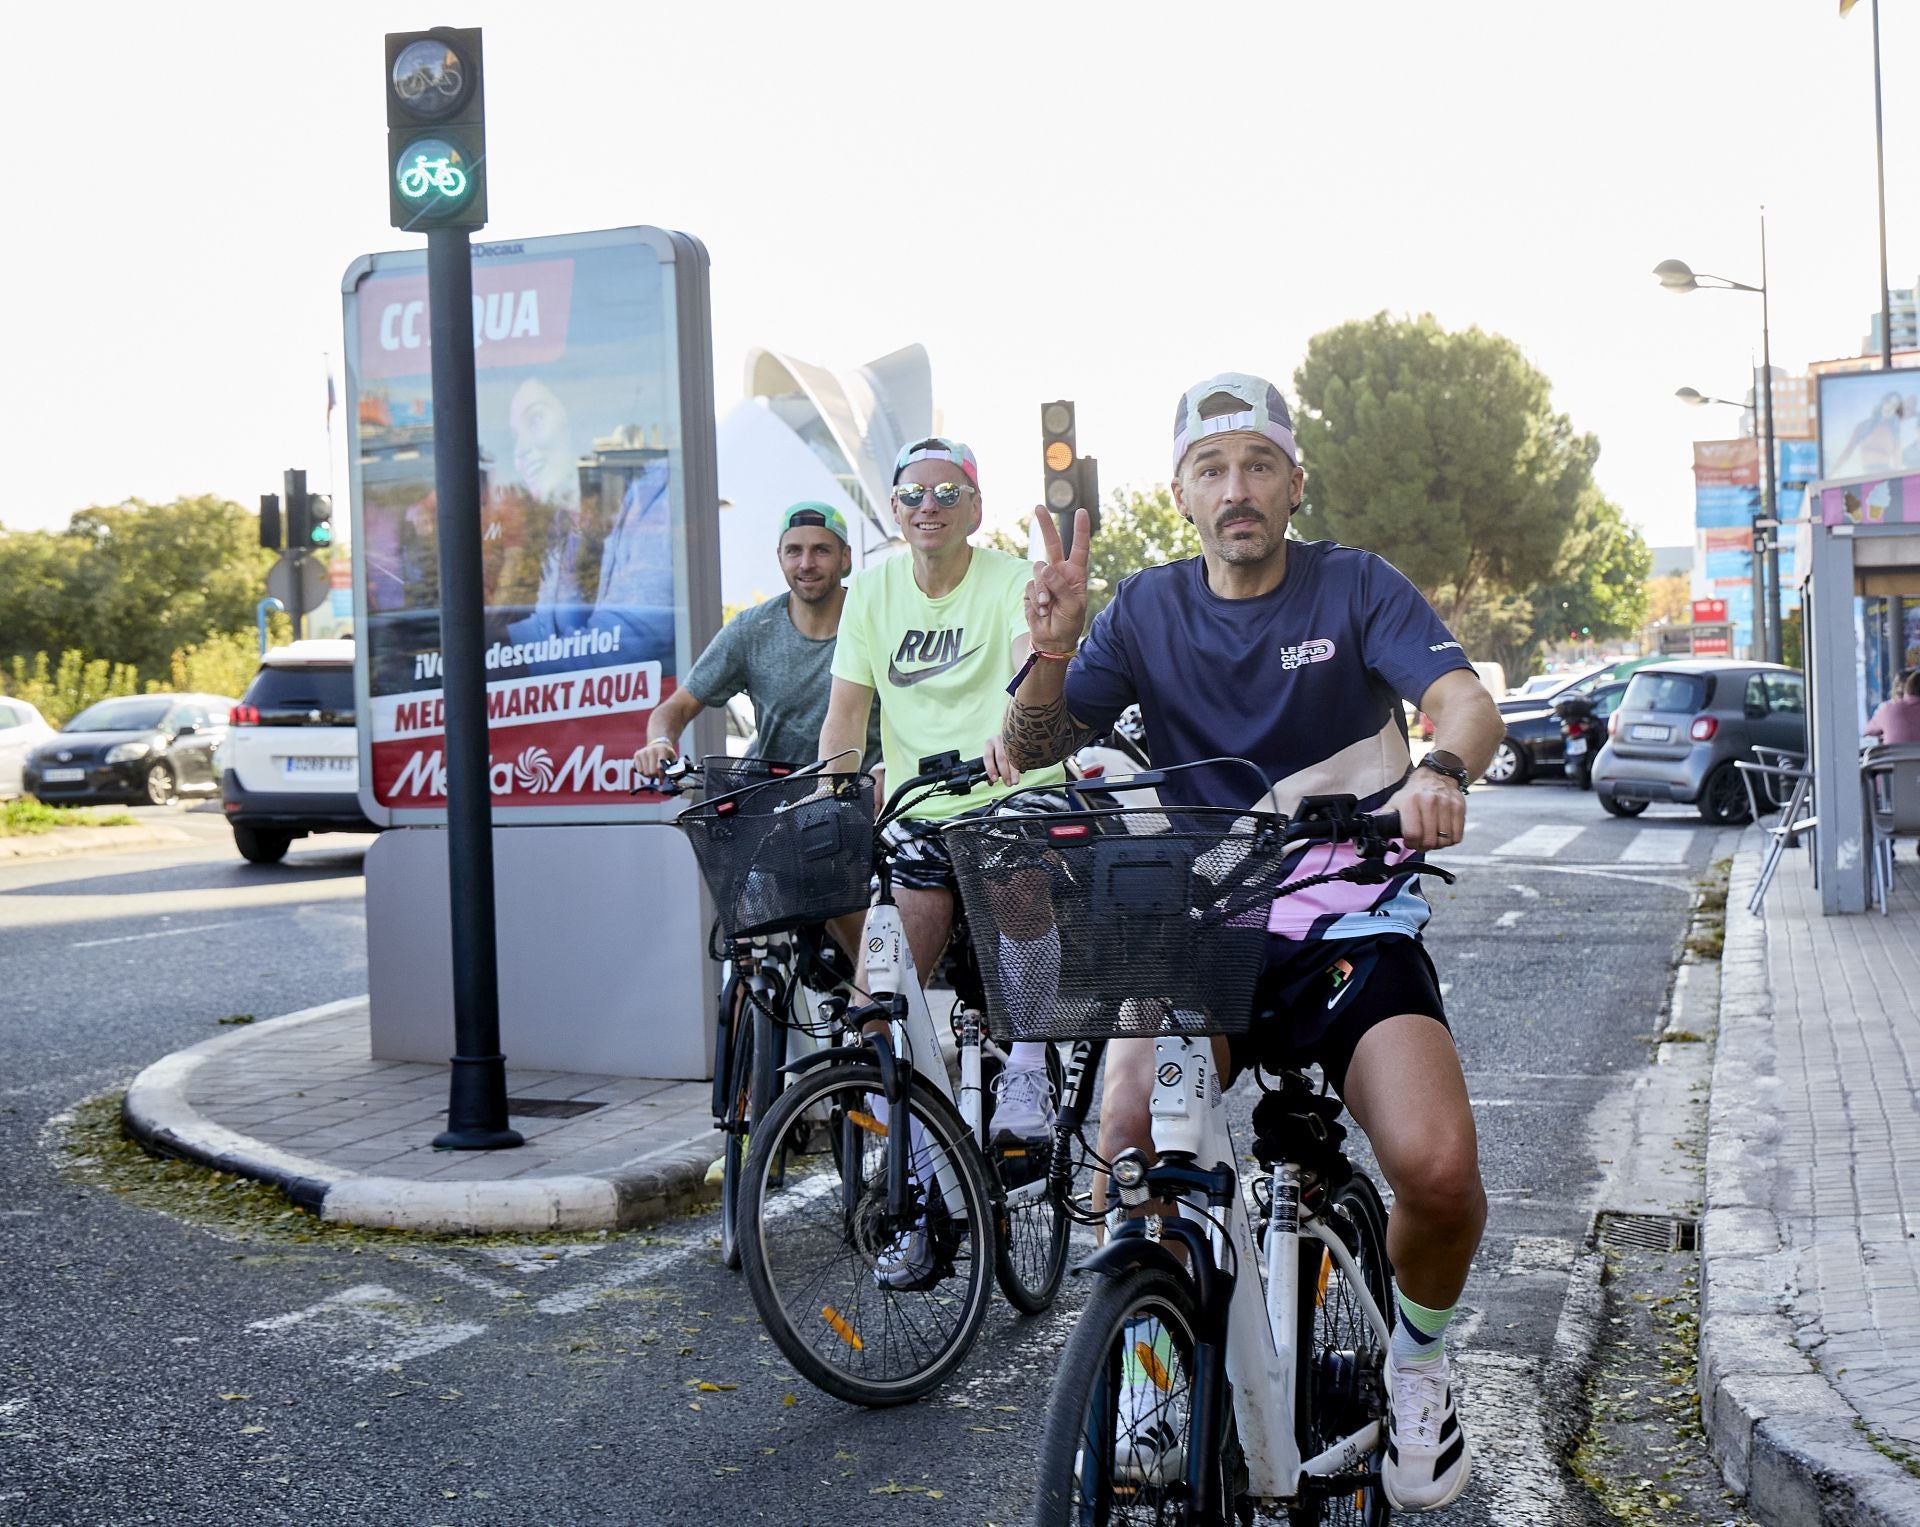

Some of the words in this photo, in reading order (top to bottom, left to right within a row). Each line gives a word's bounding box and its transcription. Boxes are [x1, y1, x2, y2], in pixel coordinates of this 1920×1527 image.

[380, 300, 424, 350] CC
[485, 624, 621, 670] descubrirlo!
[895, 627, 964, 662] RUN
[1280, 646, 1297, 655] LE
[1281, 646, 1326, 662] CAMPUS
[1282, 656, 1311, 670] CLUB
[578, 670, 649, 709] AQUA
[1195, 1067, 1206, 1100] Elsa
